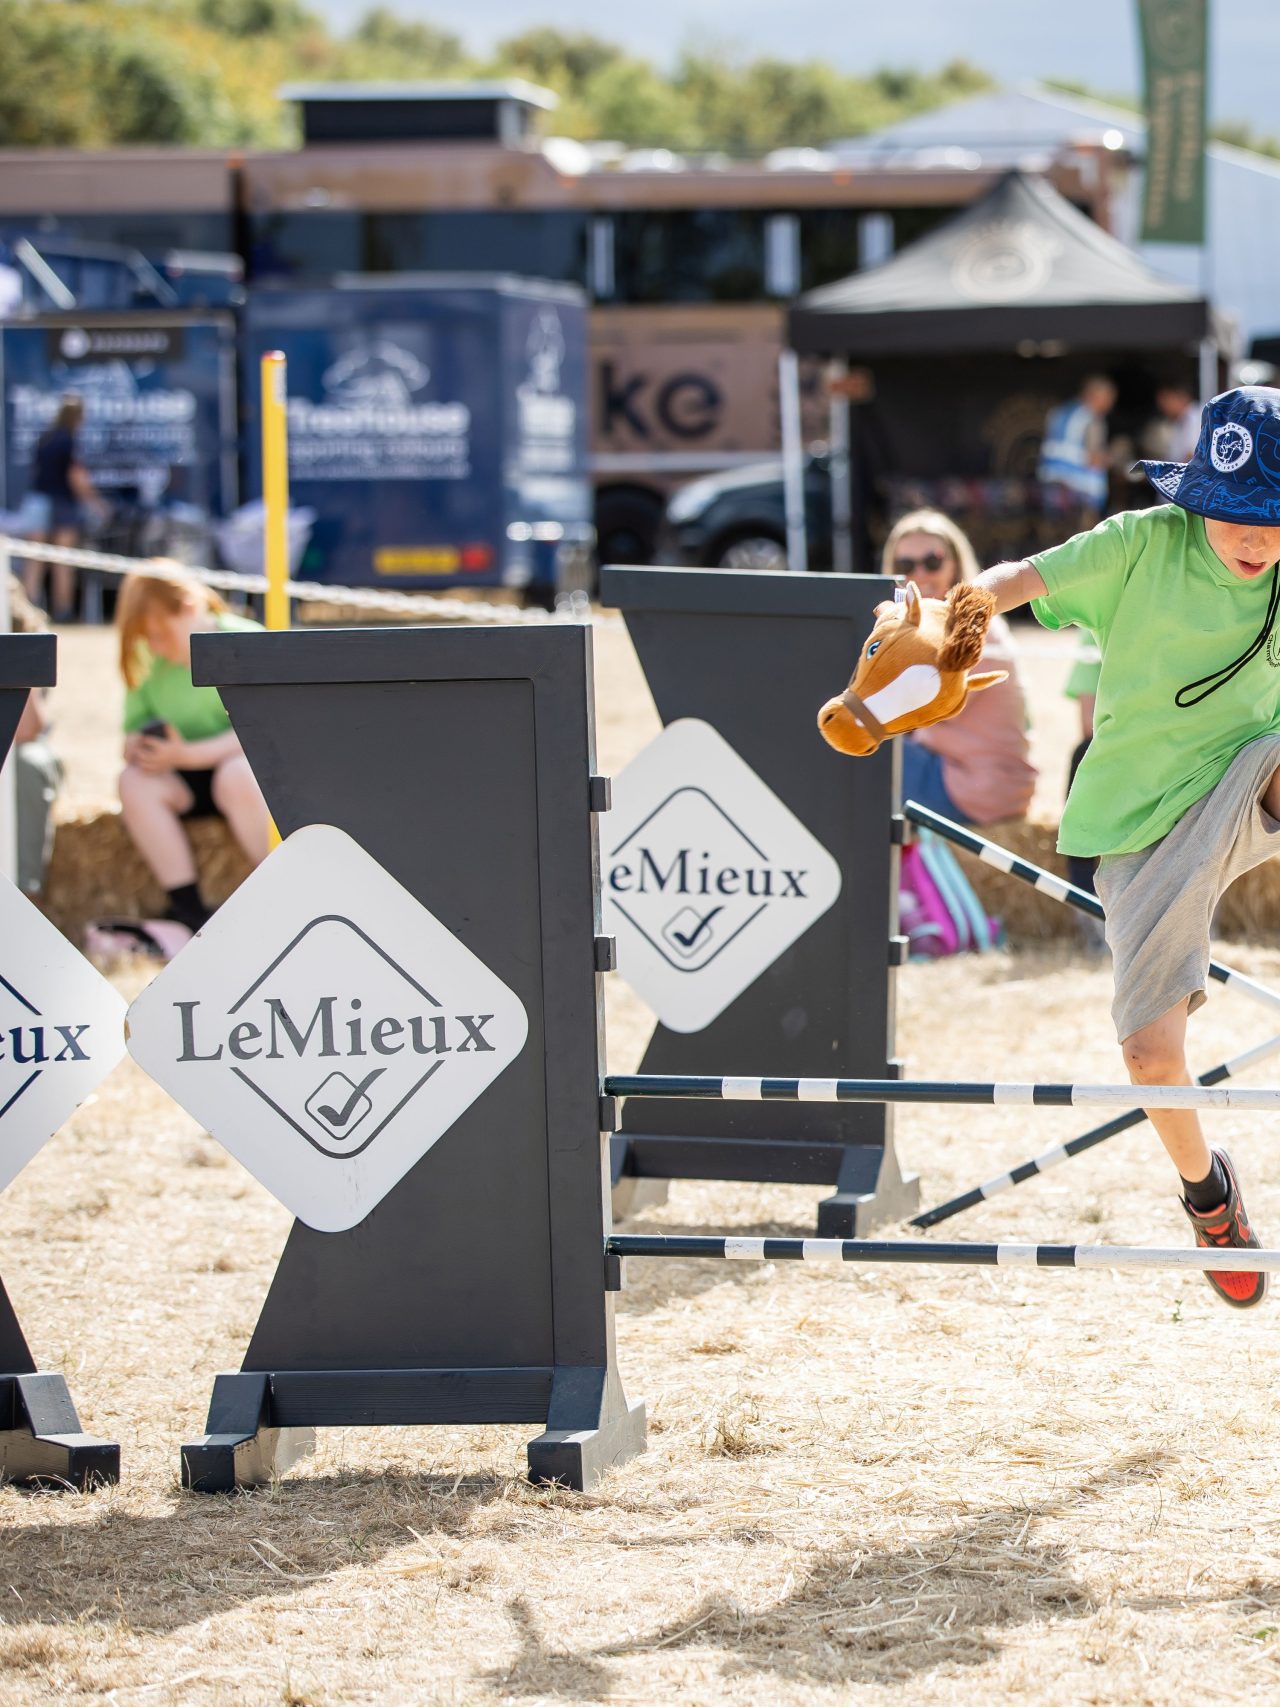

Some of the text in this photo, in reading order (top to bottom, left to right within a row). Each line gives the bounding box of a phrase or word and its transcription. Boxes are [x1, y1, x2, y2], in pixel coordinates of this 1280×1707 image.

[1243, 432, 1251, 454] CLUB
[601, 847, 807, 898] eMieux
[0, 1024, 91, 1063] ux
[173, 997, 496, 1062] LeMieux
